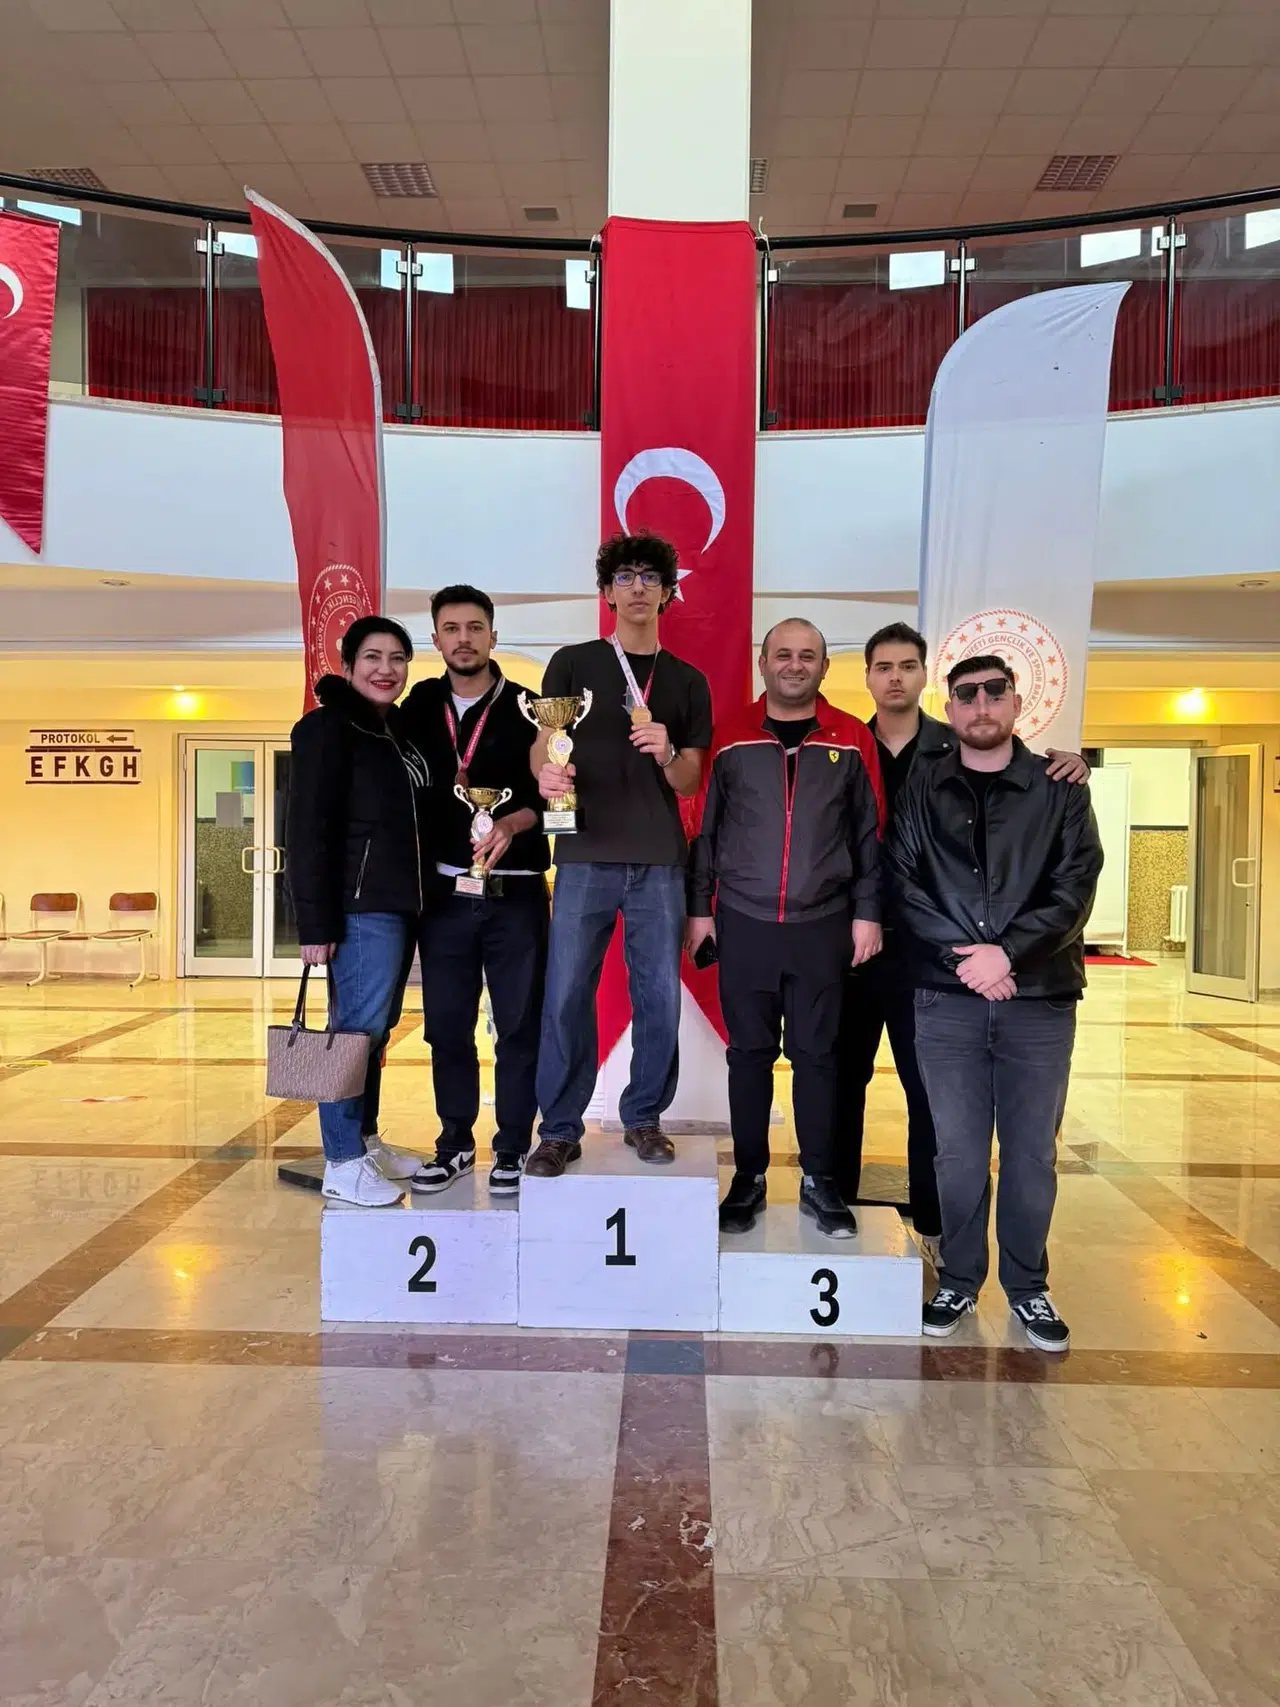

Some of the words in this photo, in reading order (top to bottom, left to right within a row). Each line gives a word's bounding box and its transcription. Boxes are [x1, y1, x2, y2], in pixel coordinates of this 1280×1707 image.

[1025, 646, 1036, 659] VE
[1031, 659, 1043, 682] SPOR
[41, 733, 100, 744] PROTOKOL
[407, 1236, 437, 1293] 2
[605, 1207, 637, 1266] 1
[810, 1268, 840, 1327] 3
